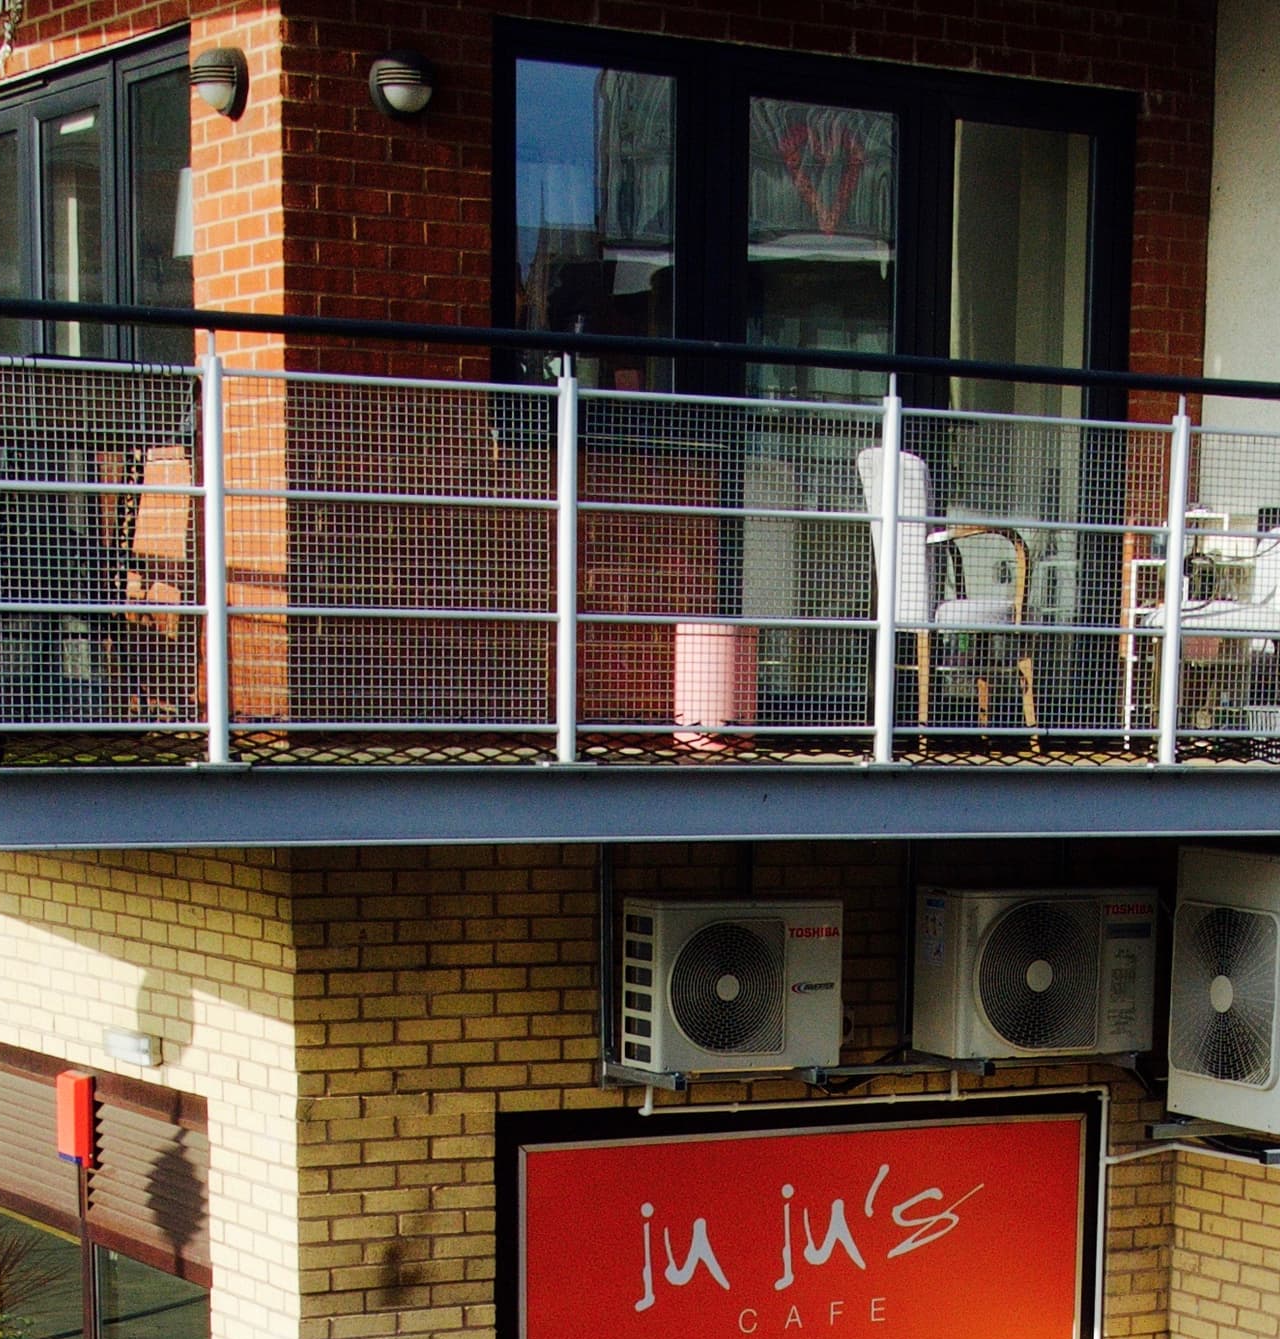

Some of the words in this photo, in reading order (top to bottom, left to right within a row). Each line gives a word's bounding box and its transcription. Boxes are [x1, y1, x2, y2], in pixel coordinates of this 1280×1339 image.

[1104, 904, 1153, 915] TOSHIBA
[789, 927, 840, 938] TOSHIBA
[634, 1202, 731, 1313] ju
[774, 1163, 985, 1291] ju's
[738, 1297, 888, 1334] CAFE
